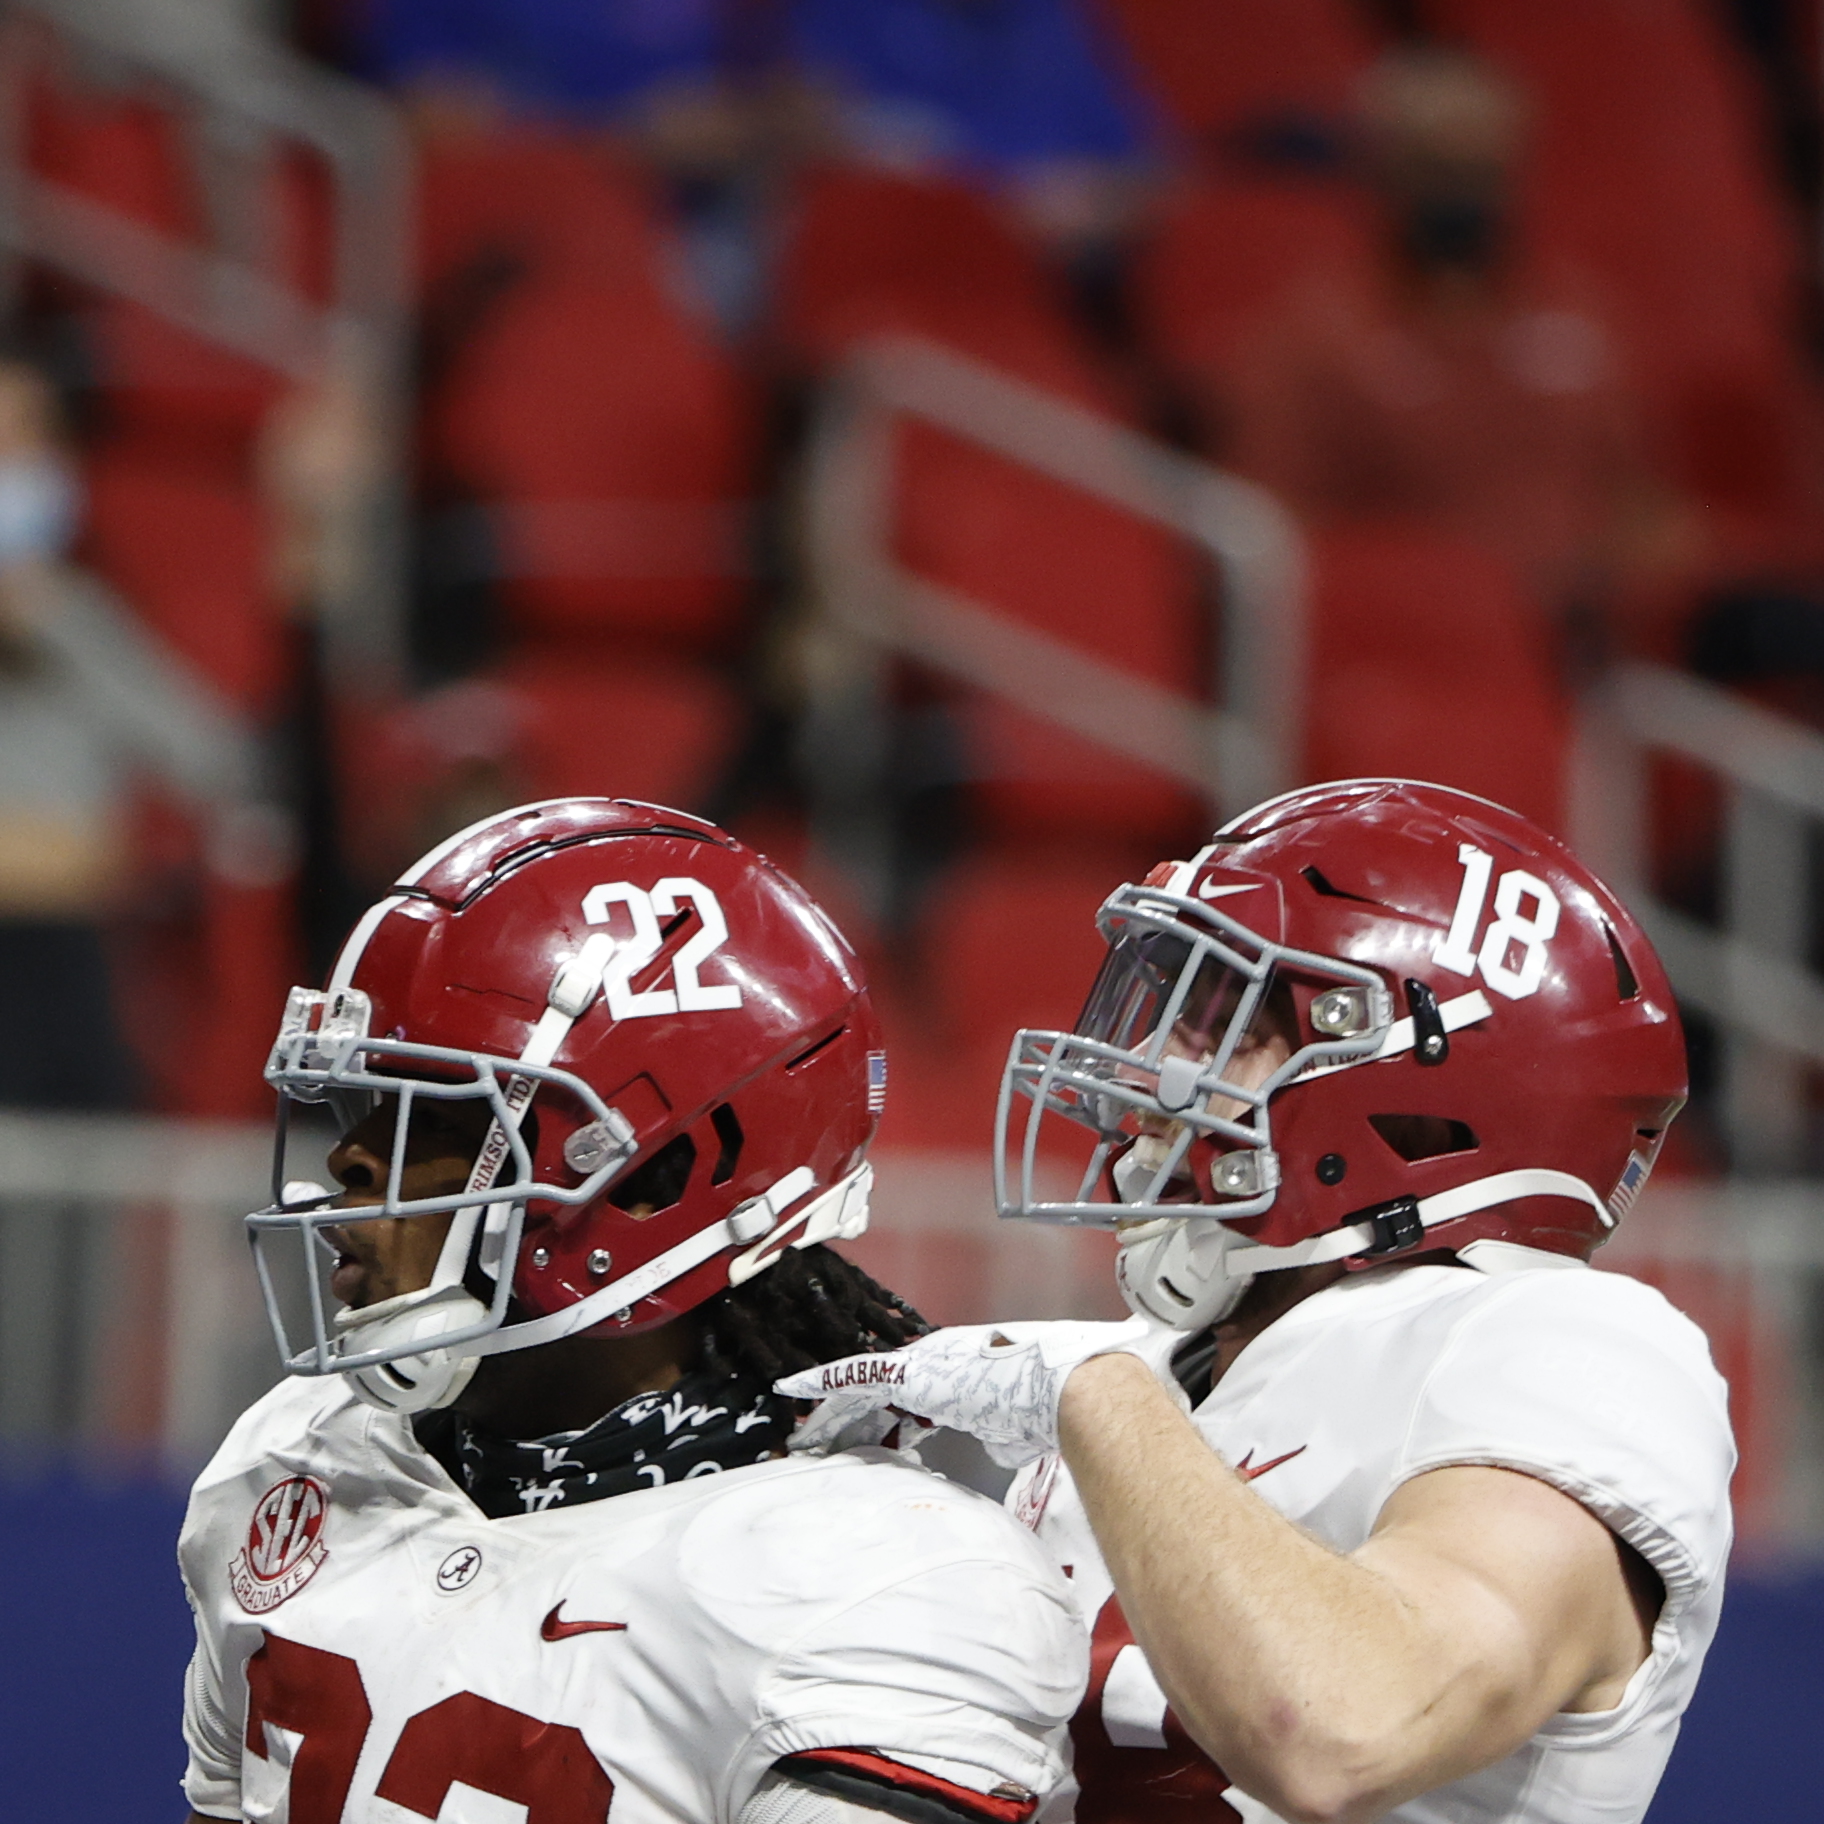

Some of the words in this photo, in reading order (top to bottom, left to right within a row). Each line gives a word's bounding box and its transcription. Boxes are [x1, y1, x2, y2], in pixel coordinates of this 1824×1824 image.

[581, 877, 743, 1021] 22
[1432, 843, 1561, 1000] 18
[470, 1121, 509, 1193] RIMSO
[822, 1360, 906, 1391] ALABAMA
[249, 1478, 322, 1575] SEC
[237, 1567, 307, 1610] GRADUATE
